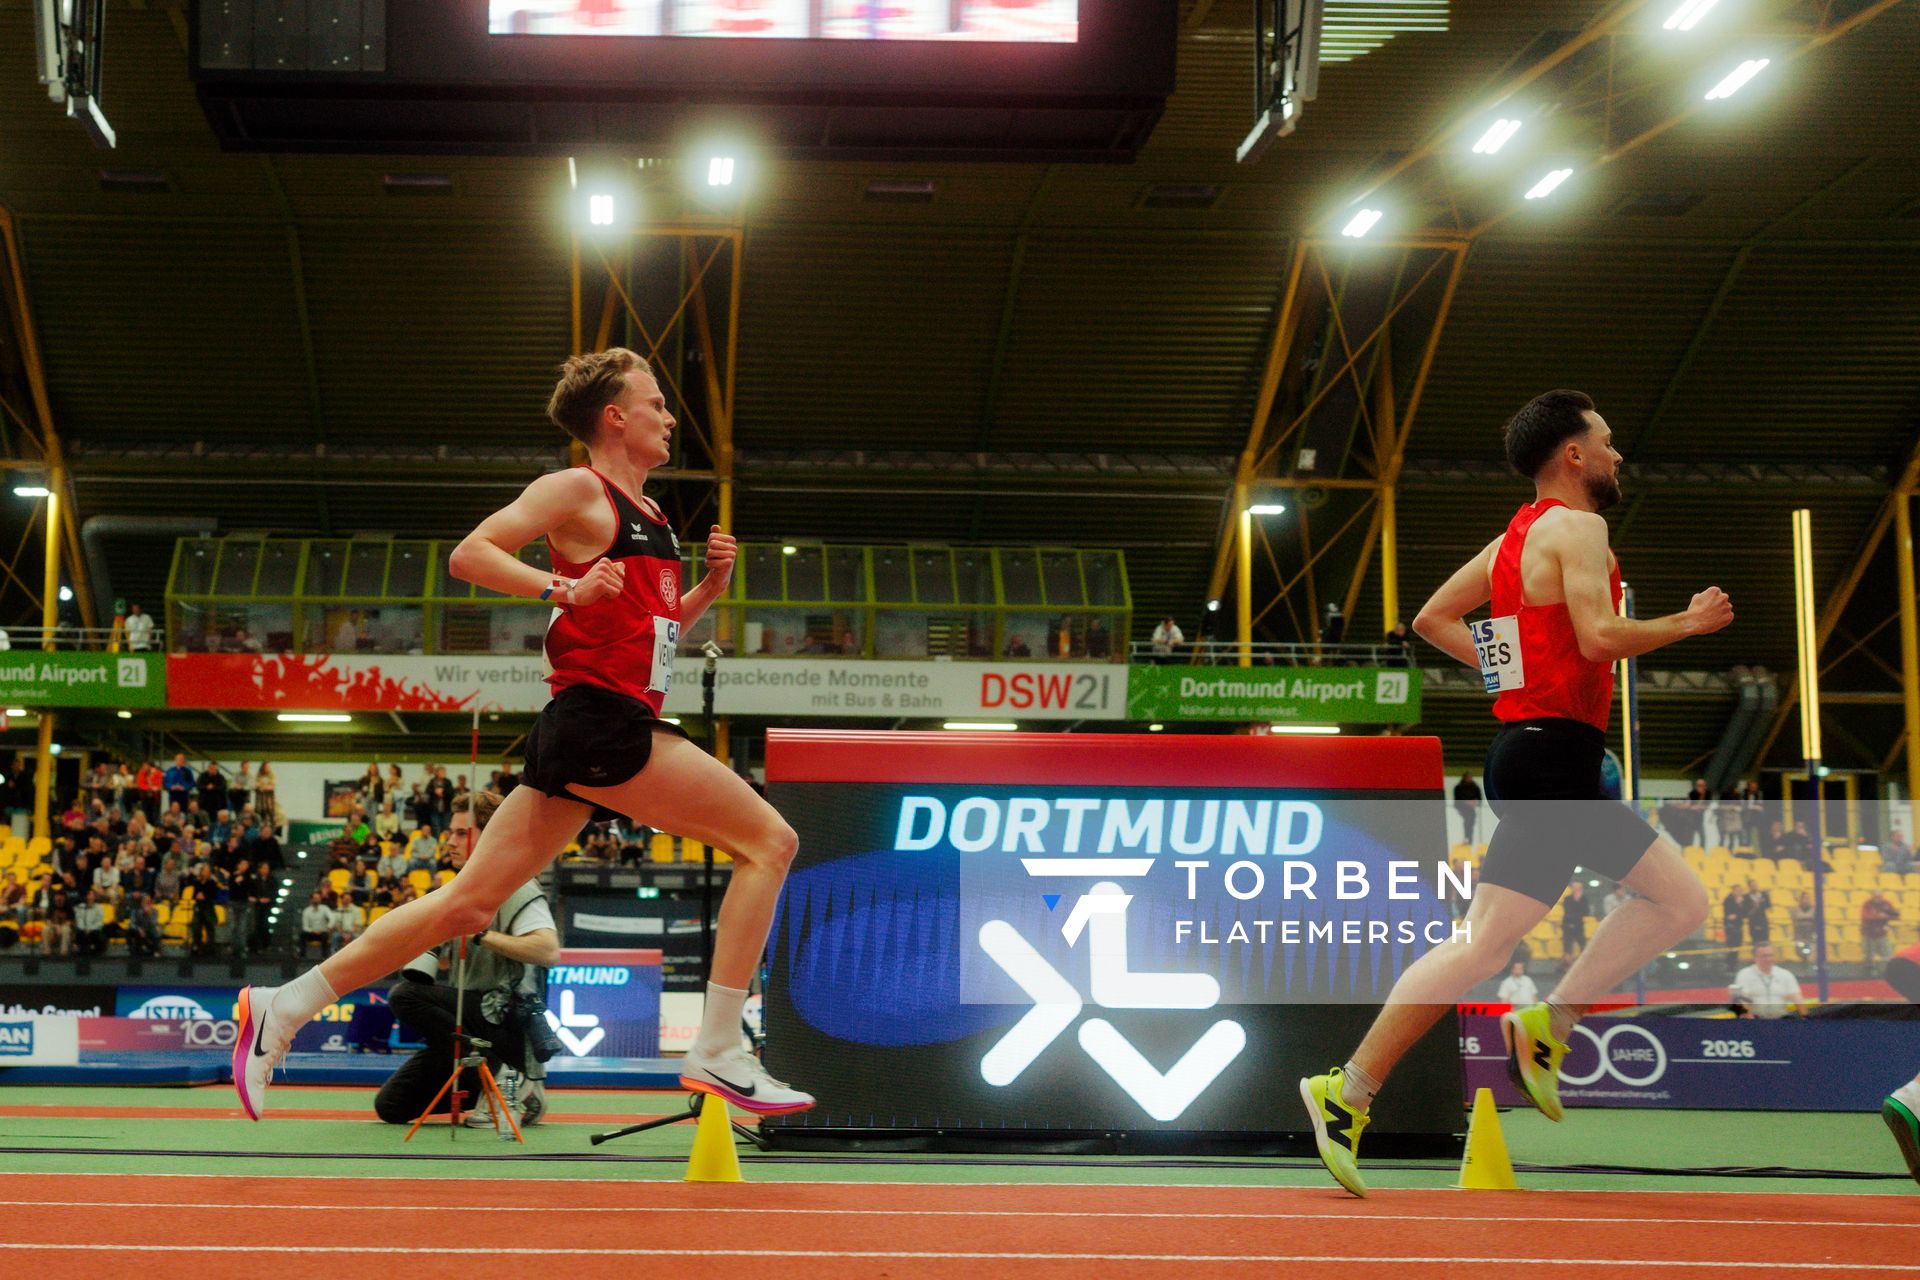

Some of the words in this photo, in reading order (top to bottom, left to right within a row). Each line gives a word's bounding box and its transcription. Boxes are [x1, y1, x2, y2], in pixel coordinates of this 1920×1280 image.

[1472, 621, 1494, 644] LS
[1476, 642, 1511, 669] RES
[40, 664, 107, 686] Airport
[435, 666, 469, 682] Wir
[718, 669, 821, 688] packende
[828, 670, 929, 688] Momente
[812, 693, 839, 707] mit
[844, 693, 875, 707] Bus
[881, 694, 893, 708] &
[899, 693, 942, 708] Bahn
[1180, 677, 1285, 698] Dortmund
[1290, 679, 1364, 703] Airport
[894, 796, 1324, 856] DORTMUND
[181, 1020, 238, 1045] 100
[1701, 1040, 1755, 1057] 2026
